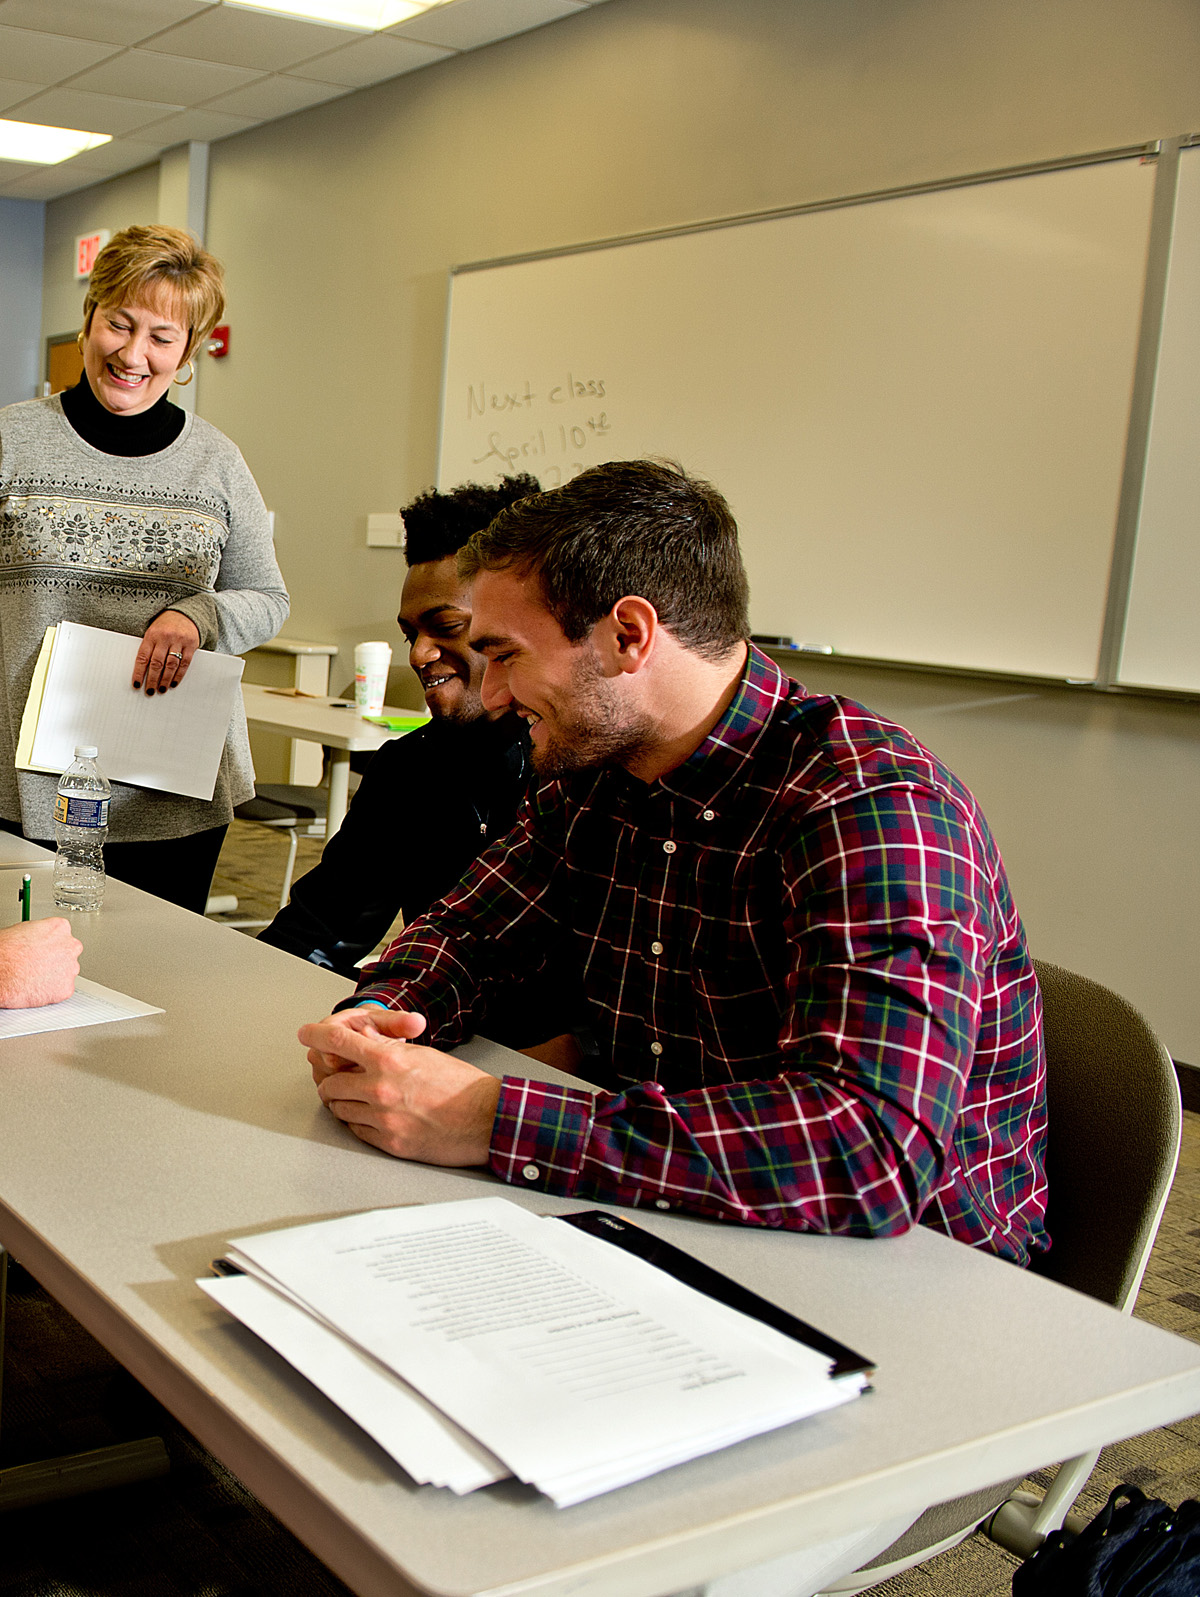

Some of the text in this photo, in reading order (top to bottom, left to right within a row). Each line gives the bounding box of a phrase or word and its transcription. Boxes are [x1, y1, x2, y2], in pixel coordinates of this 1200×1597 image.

[78, 235, 100, 275] EXIT
[467, 372, 606, 420] Next class
[472, 429, 546, 471] April
